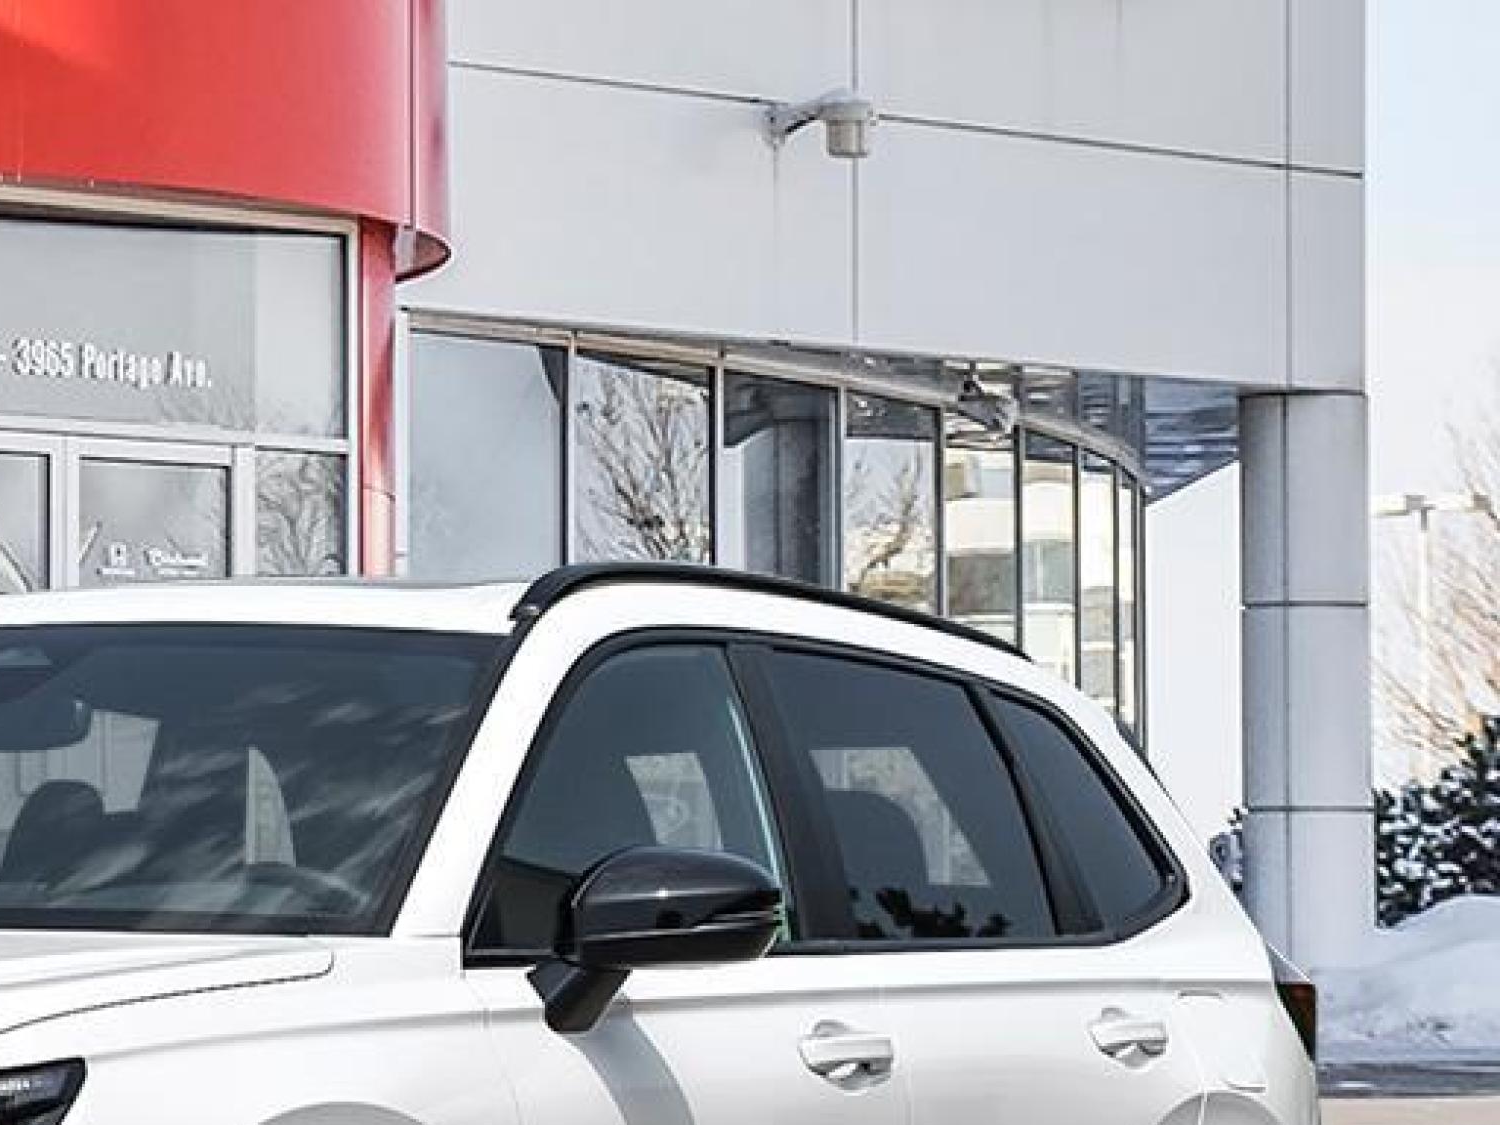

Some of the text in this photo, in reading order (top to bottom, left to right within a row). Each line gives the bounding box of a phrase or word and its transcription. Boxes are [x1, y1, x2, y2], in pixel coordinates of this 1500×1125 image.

[14, 337, 75, 377] 3965
[81, 342, 162, 390] Portage
[167, 350, 212, 388] Ave.
